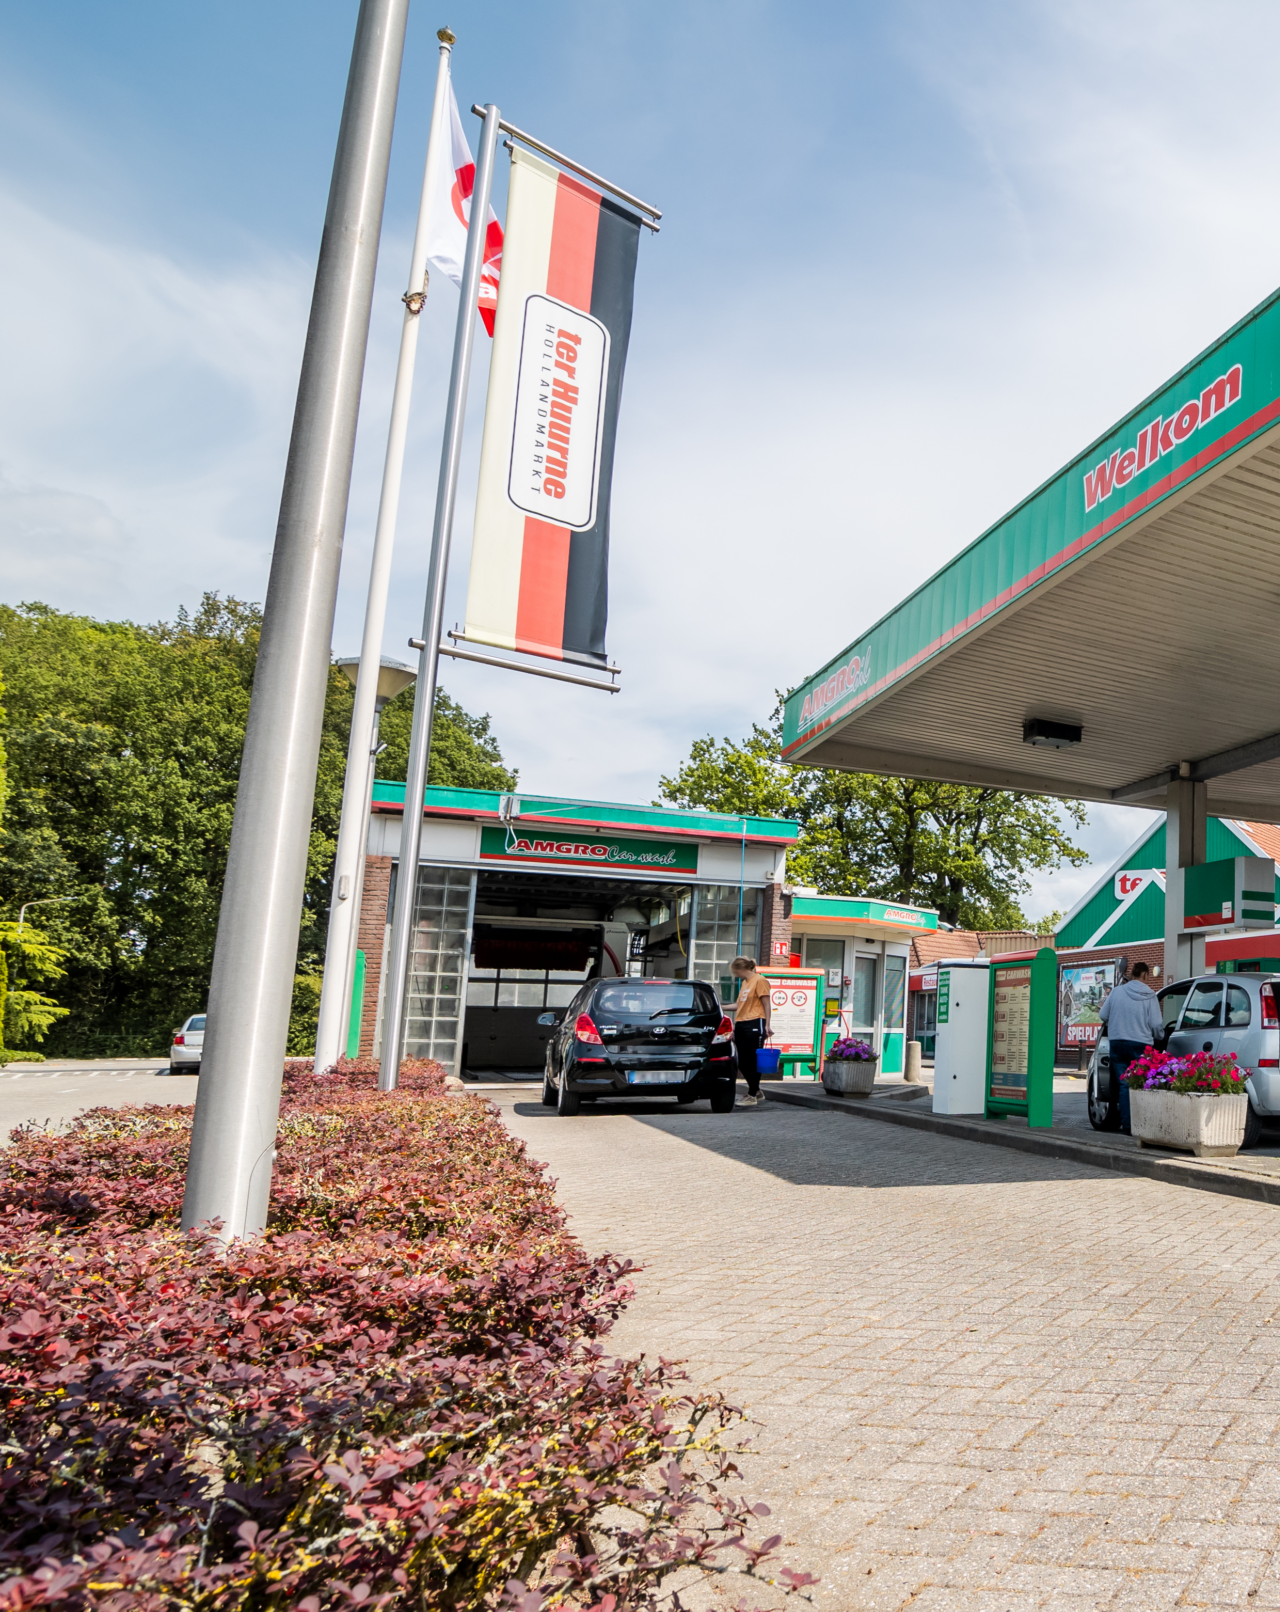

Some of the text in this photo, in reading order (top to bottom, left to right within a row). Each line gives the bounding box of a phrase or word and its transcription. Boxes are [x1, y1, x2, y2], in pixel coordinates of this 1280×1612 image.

[531, 324, 555, 494] HOLLANDMARKT
[543, 328, 582, 500] ter Huurne
[1083, 363, 1243, 513] Welkom
[798, 645, 872, 726] AMGRO oil
[510, 839, 676, 865] AMGRO Car wash
[884, 909, 917, 921] AMGRO
